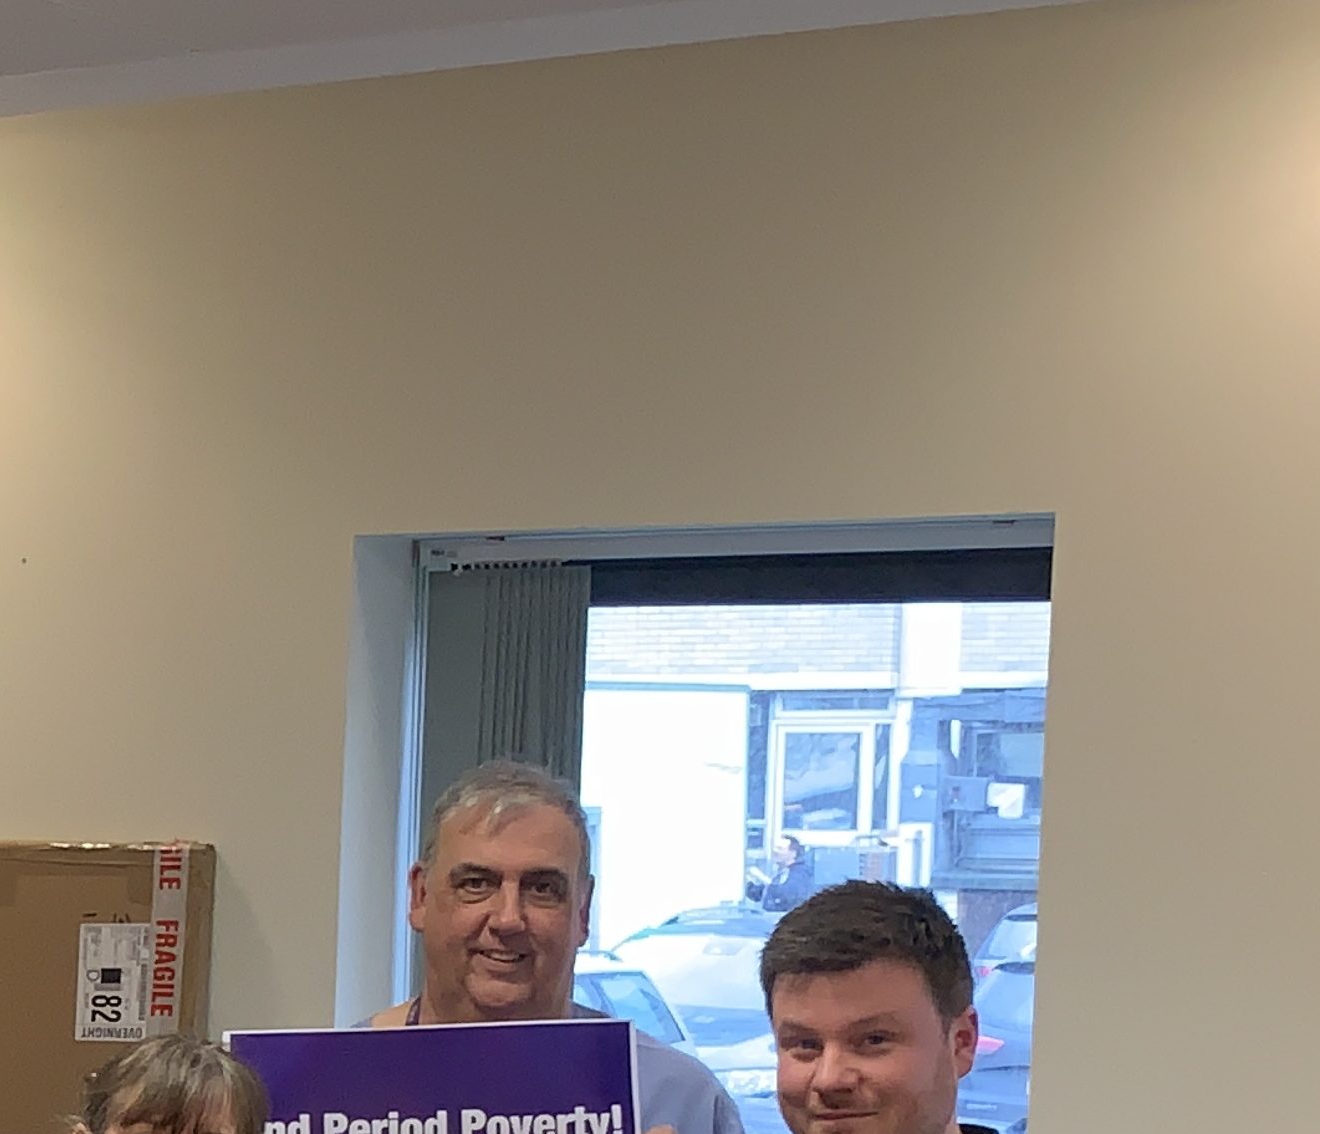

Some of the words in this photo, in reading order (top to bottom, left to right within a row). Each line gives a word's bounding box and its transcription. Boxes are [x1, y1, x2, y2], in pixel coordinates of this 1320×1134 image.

[150, 919, 179, 1018] FRAGILE
[91, 994, 122, 1023] 82
[80, 1026, 143, 1039] OVERNIGHT
